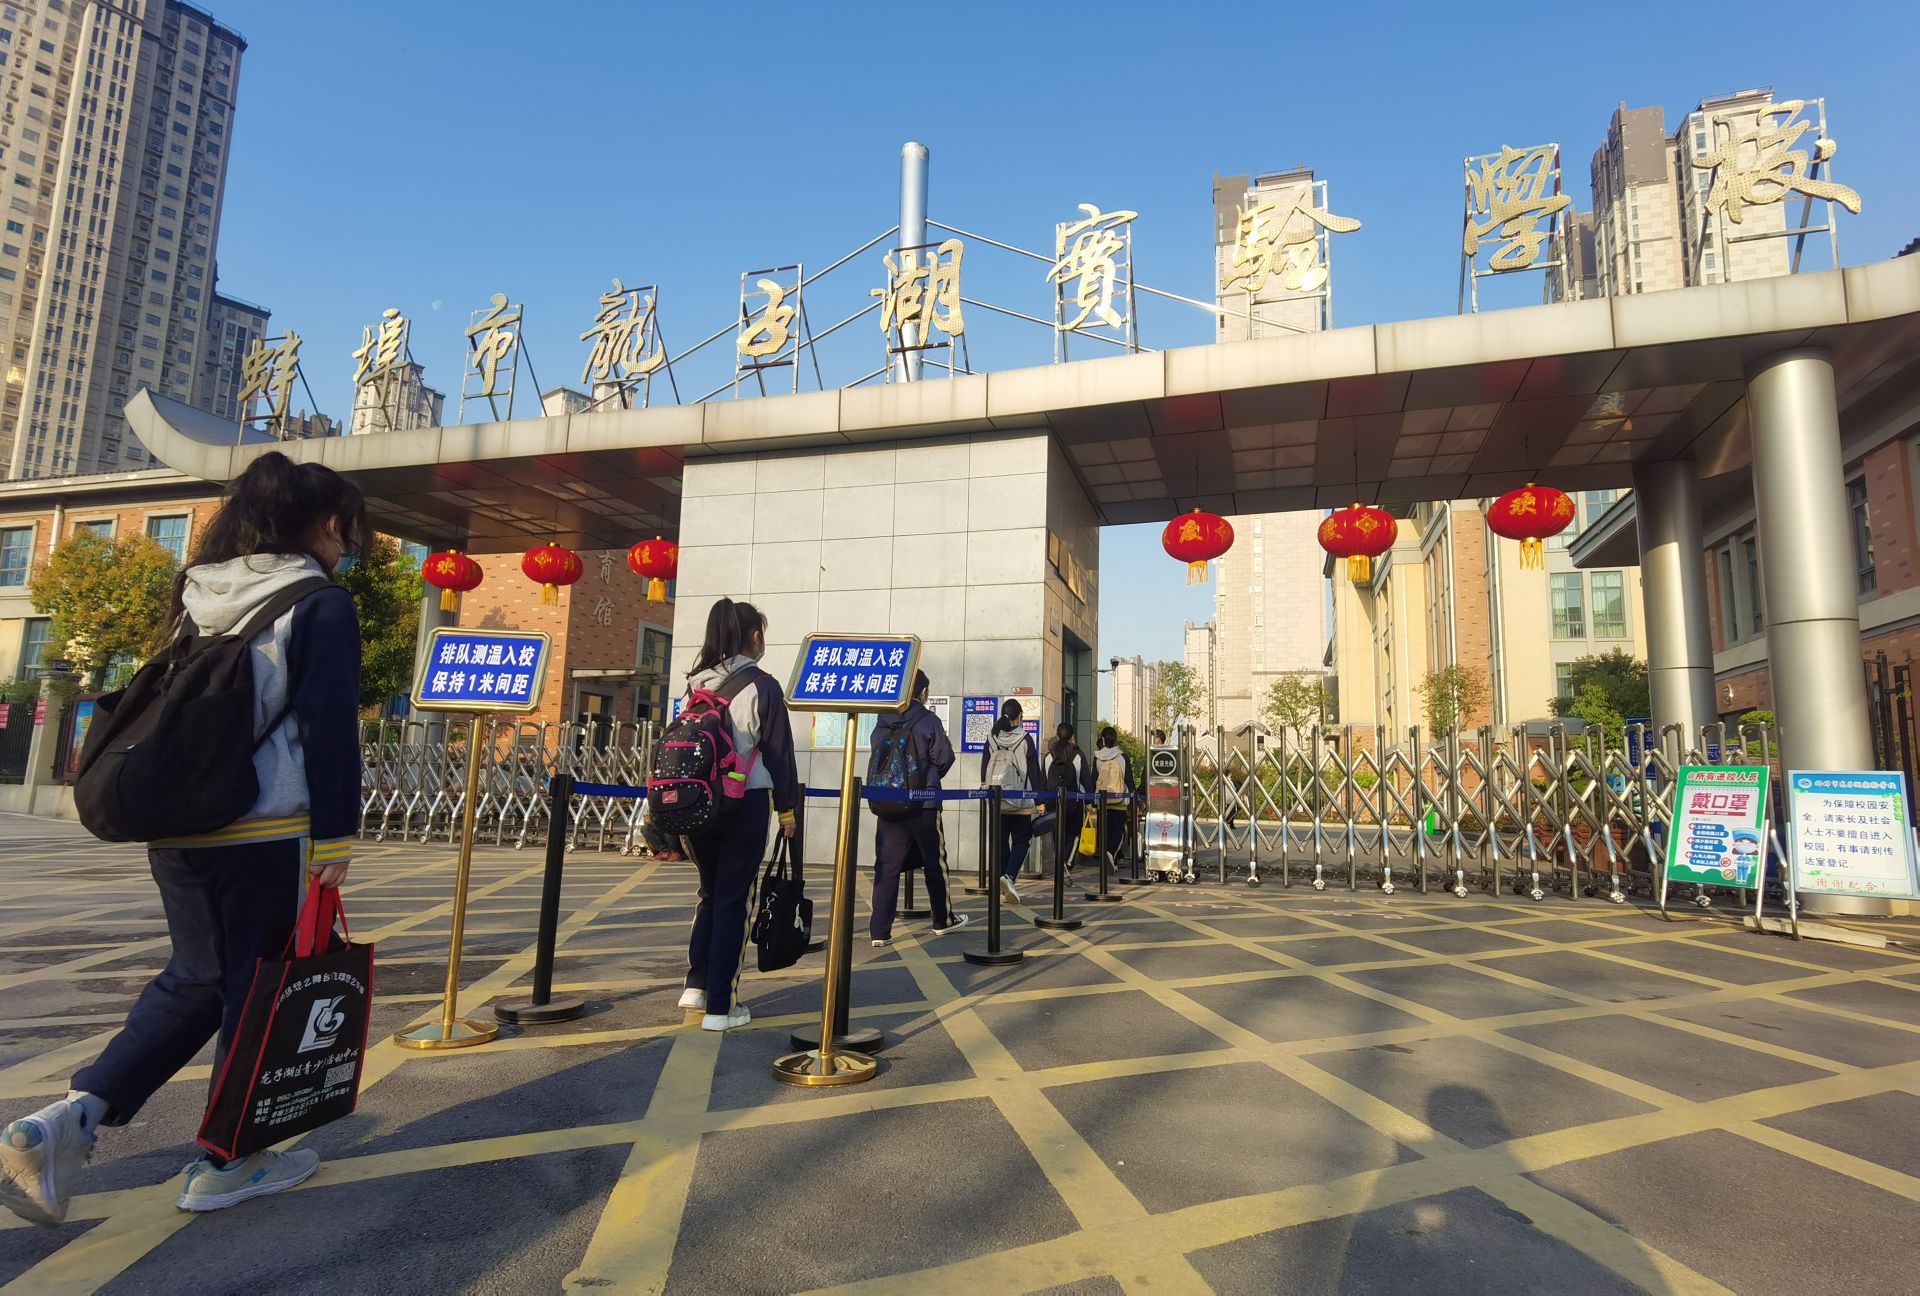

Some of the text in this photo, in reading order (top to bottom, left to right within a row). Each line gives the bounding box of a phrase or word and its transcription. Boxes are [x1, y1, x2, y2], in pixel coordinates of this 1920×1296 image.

[439, 643, 536, 667] 排队测温入校
[812, 646, 905, 668] 排队测温入校
[431, 670, 530, 695] 保持1米间距
[804, 672, 899, 694] 保持1米间距
[1690, 792, 1750, 811] 戴口罩
[1823, 799, 1889, 810] 为保障校园安
[1803, 828, 1893, 840] 人士不要擅自进入
